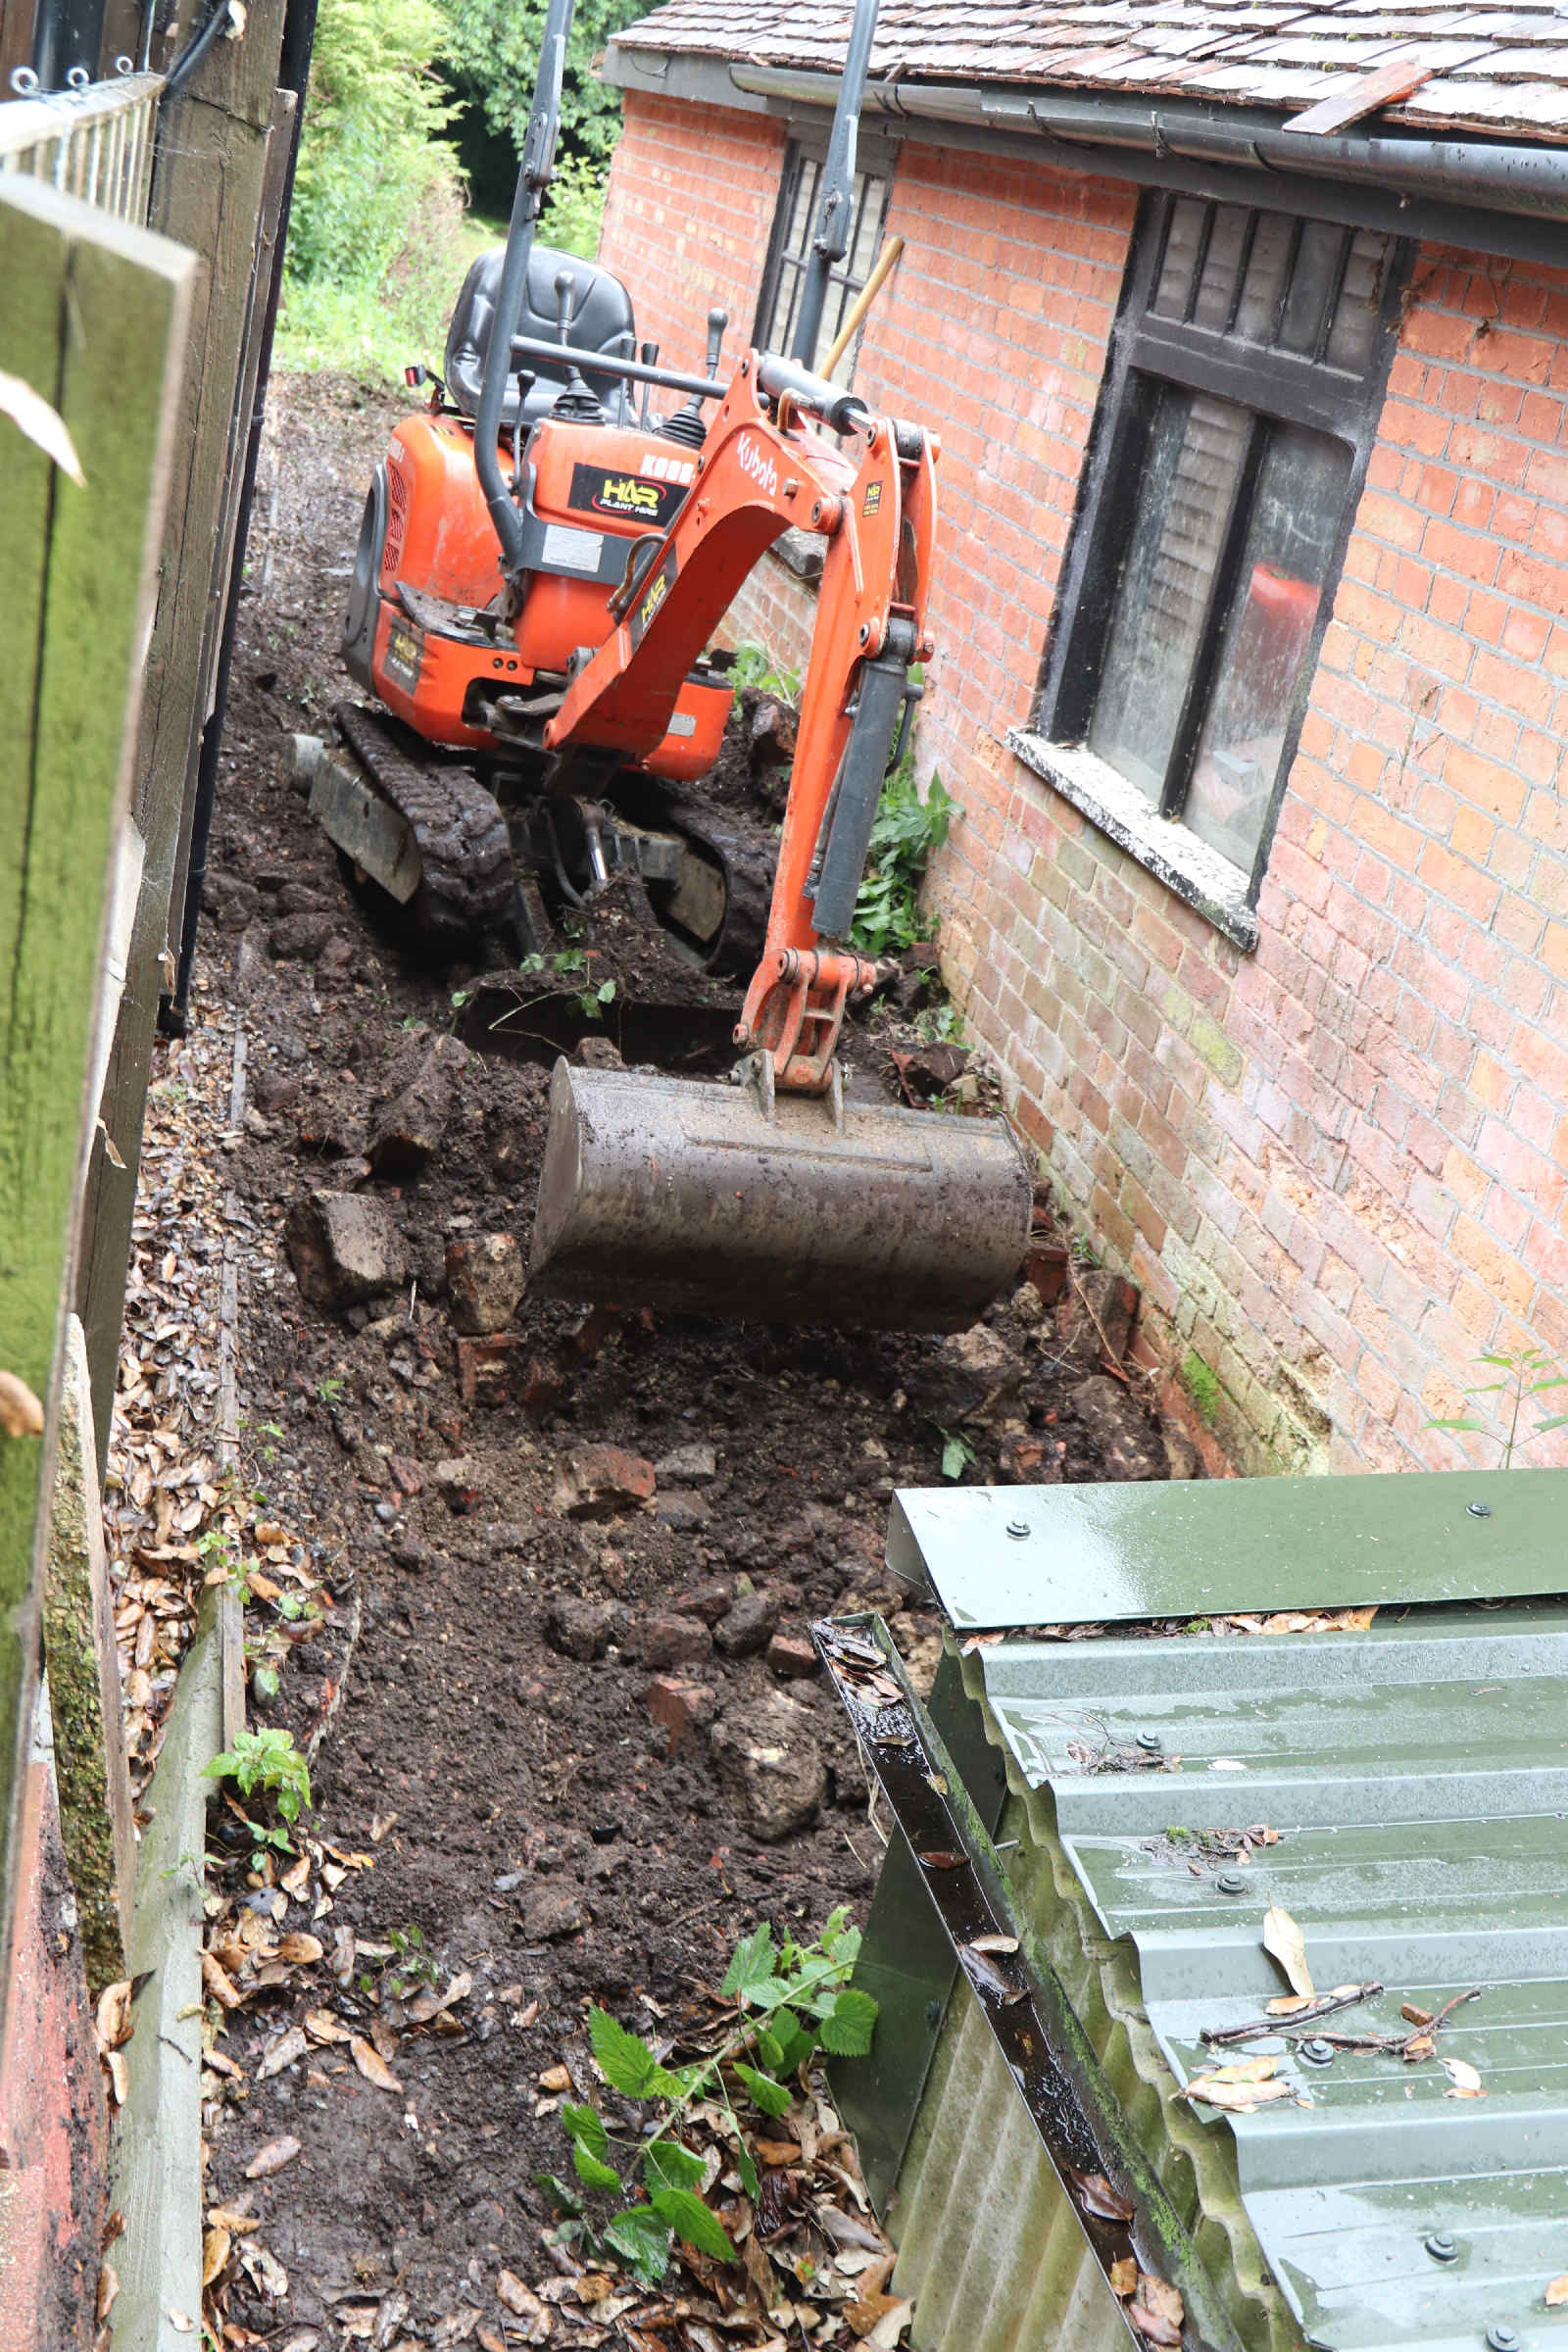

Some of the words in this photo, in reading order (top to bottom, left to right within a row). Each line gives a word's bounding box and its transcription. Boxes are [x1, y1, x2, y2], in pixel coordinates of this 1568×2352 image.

[737, 432, 777, 497] Kubota
[600, 498, 634, 512] PLANT
[635, 506, 659, 516] HIRE
[603, 479, 659, 508] HAR
